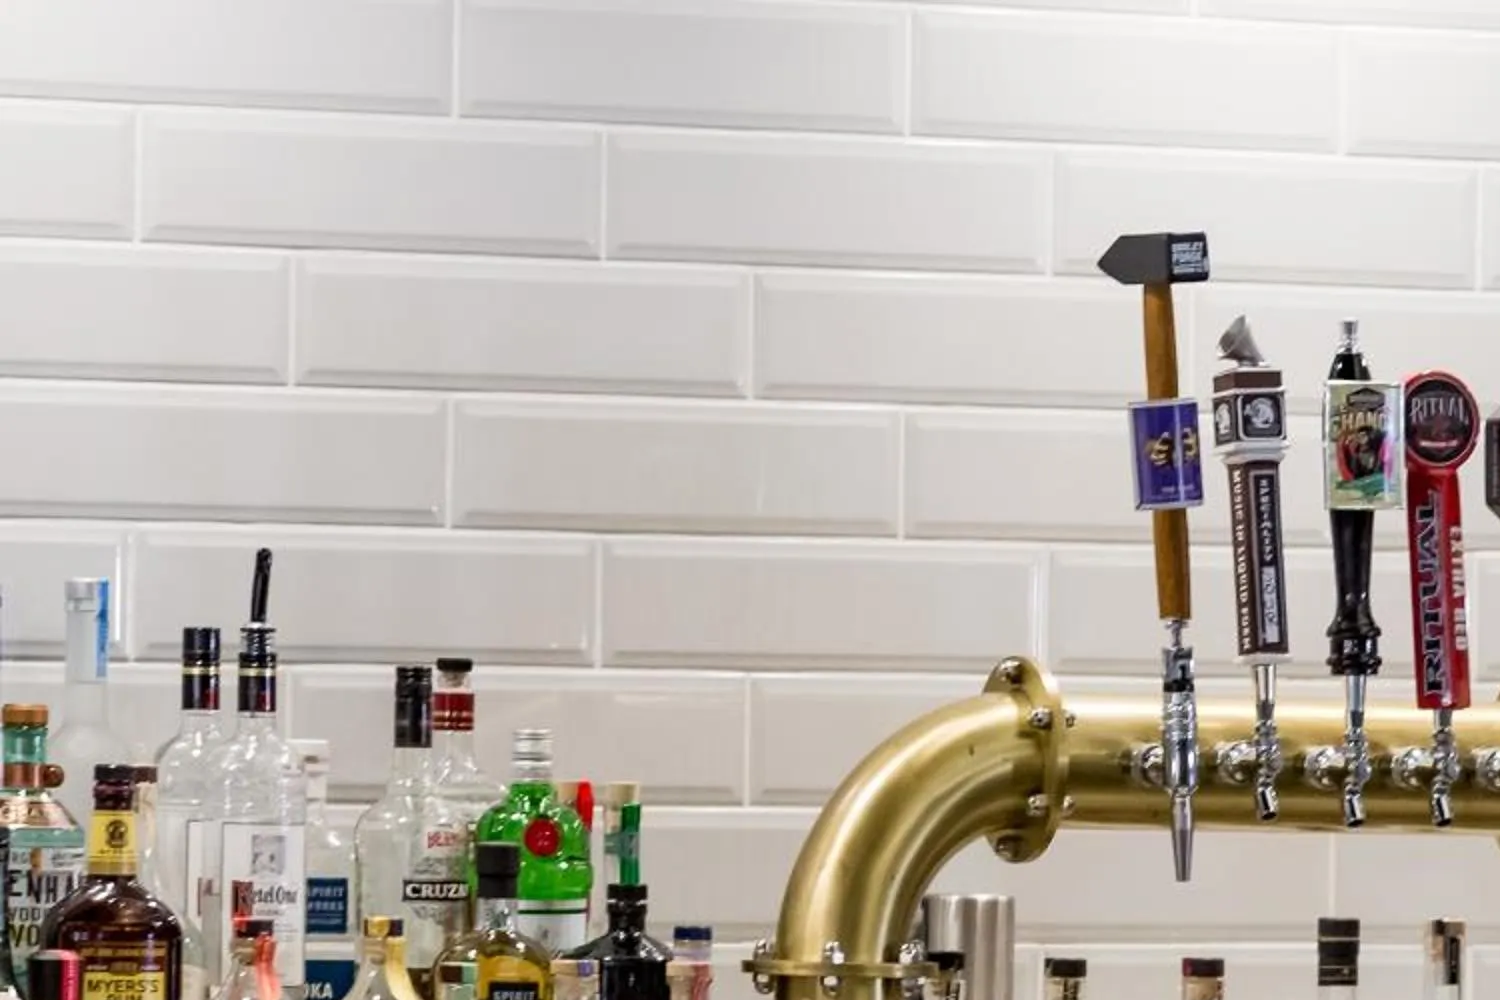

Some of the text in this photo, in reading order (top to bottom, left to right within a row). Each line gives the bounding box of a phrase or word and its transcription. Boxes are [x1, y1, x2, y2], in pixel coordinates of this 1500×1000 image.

[1416, 489, 1447, 697] RITUAL
[1450, 525, 1466, 599] EXTRA
[86, 979, 159, 992] MYERS'S
